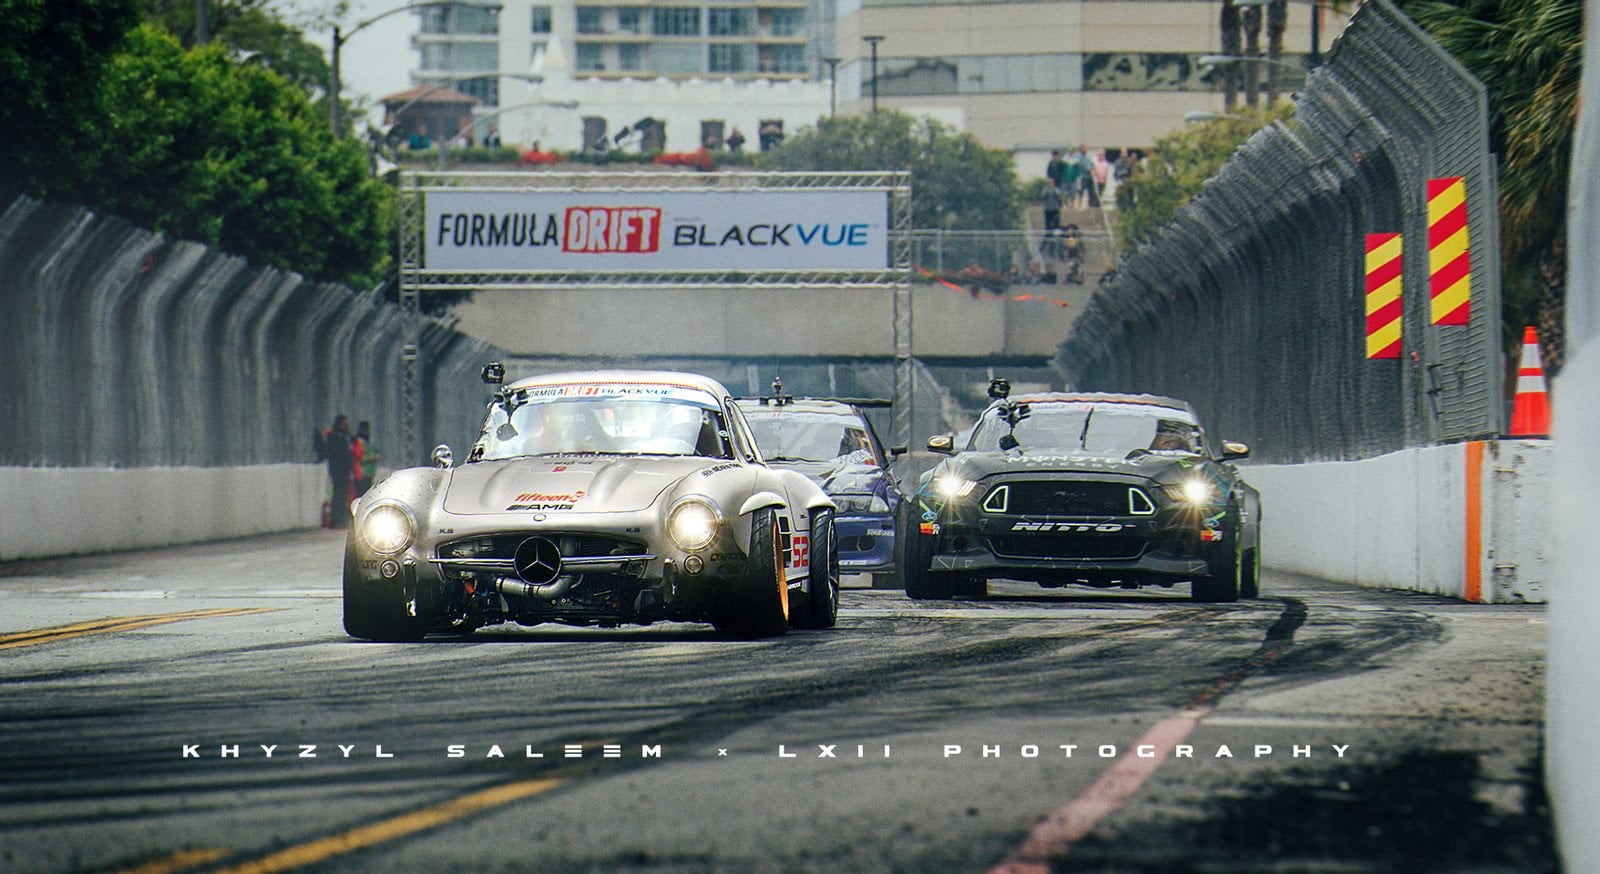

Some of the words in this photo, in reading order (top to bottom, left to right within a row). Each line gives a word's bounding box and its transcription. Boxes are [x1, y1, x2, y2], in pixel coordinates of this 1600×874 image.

[438, 212, 558, 247] FORMULA
[567, 208, 659, 251] DRIFT
[673, 223, 869, 247] BLACKVUE
[529, 388, 563, 398] ORMULA
[1011, 522, 1123, 532] NITTO
[793, 536, 808, 568] 52
